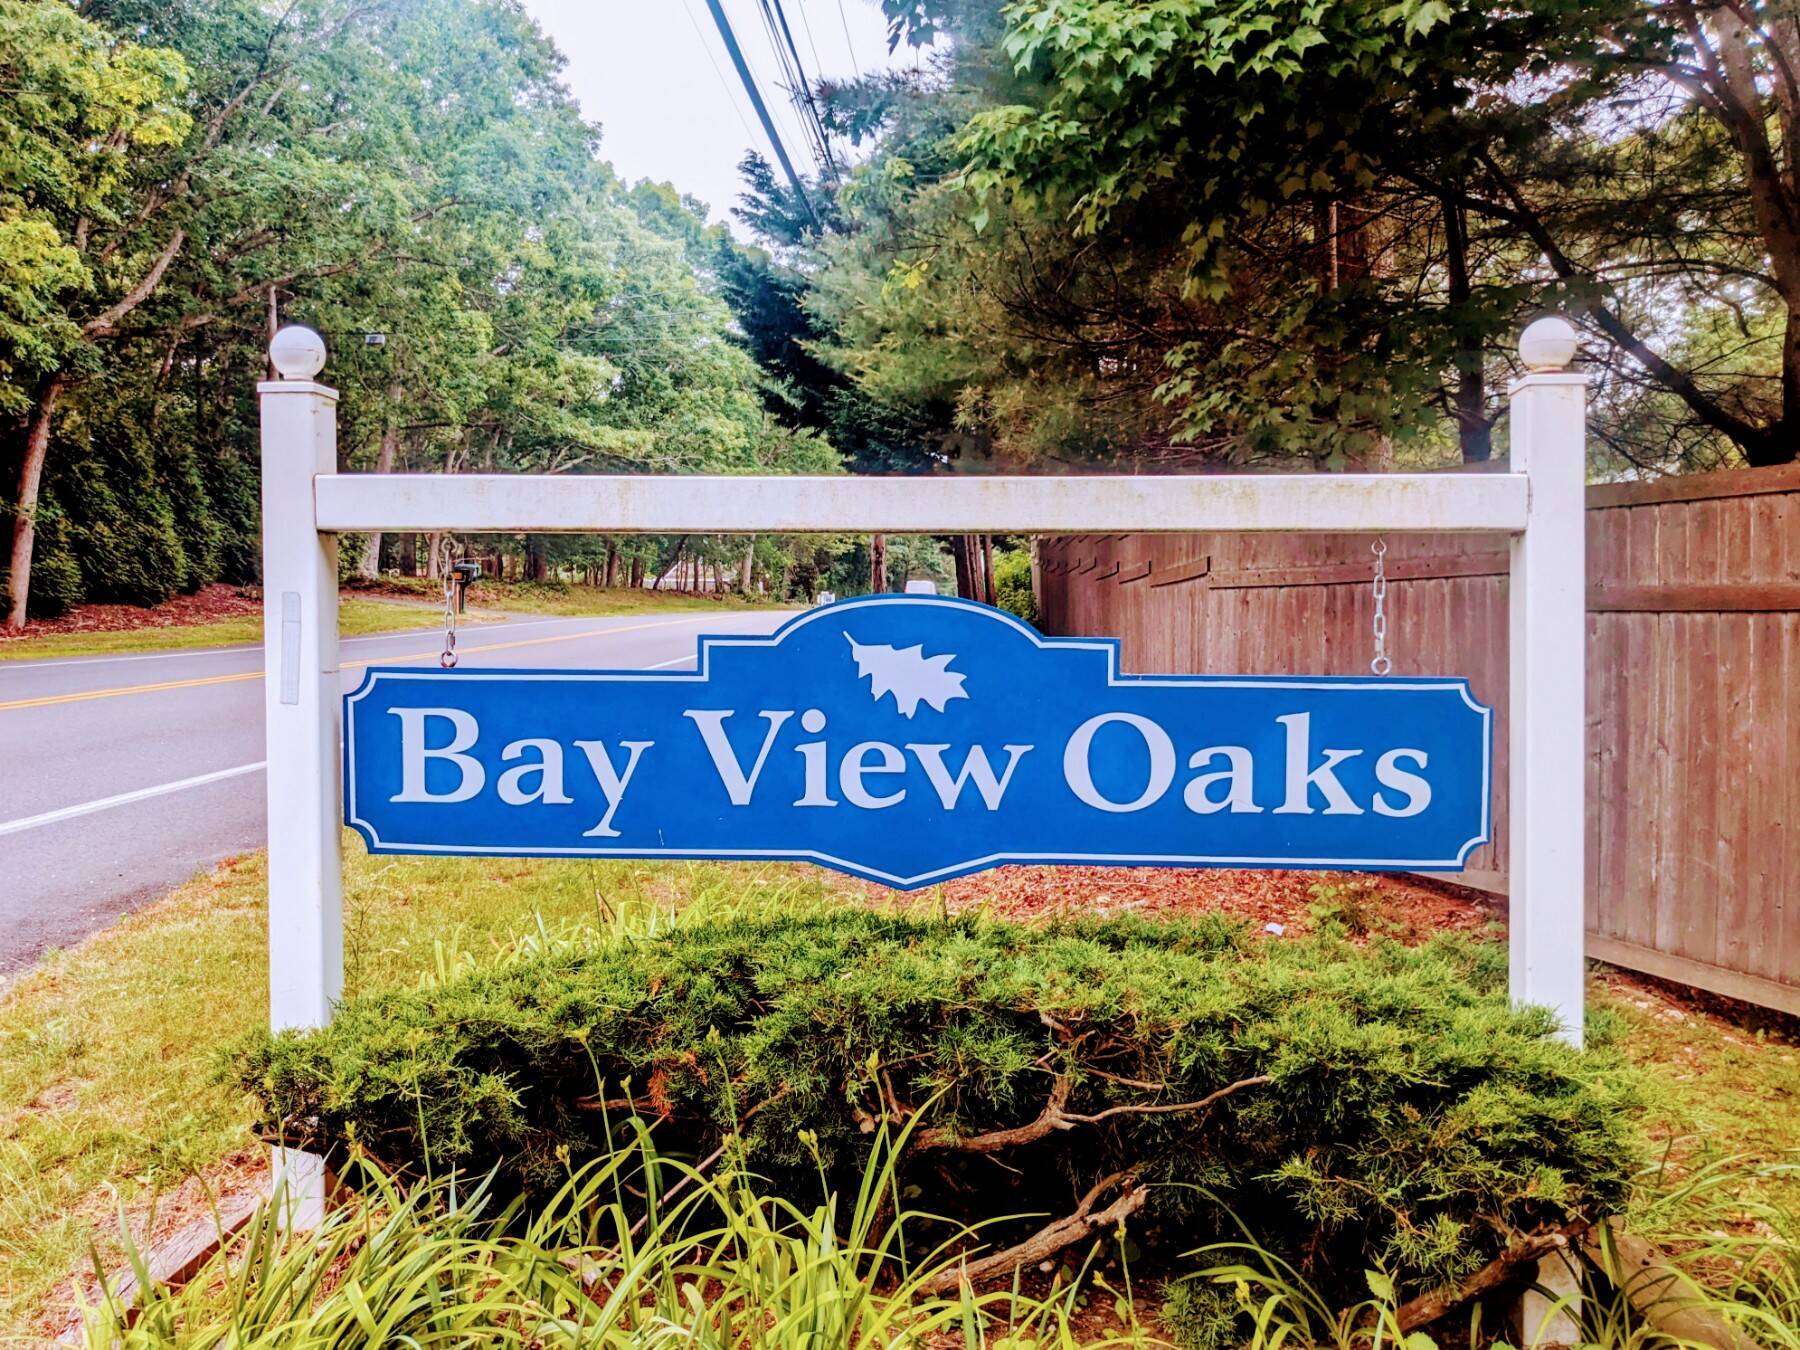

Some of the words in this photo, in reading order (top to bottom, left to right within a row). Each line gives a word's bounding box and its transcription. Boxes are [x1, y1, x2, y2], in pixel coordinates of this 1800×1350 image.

[387, 707, 655, 838] Bay
[683, 708, 1034, 811] View
[1063, 711, 1432, 818] Oaks
